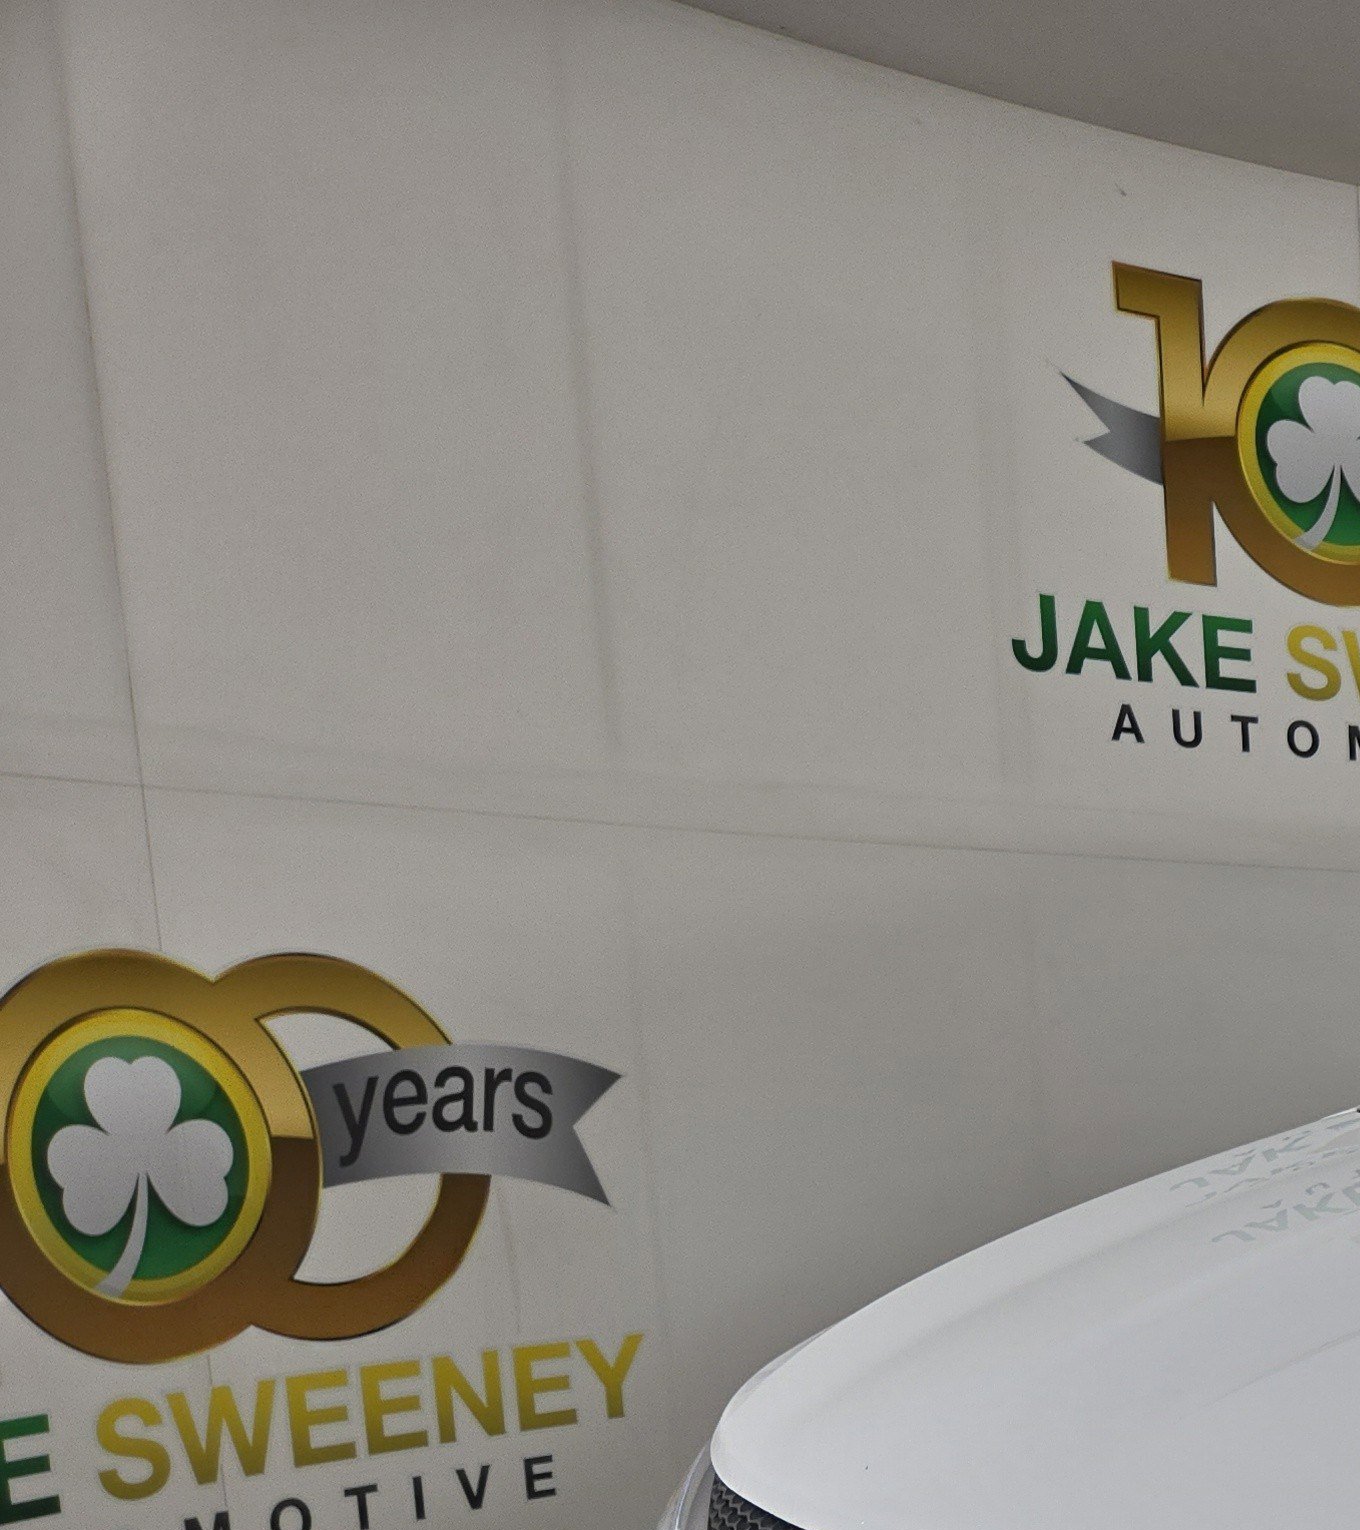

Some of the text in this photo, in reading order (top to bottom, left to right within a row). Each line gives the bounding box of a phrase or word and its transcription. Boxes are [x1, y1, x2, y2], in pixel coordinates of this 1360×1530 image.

[1011, 594, 1256, 693] JAKE
[0, 948, 491, 1364] 00
[334, 1065, 554, 1167] years
[97, 1333, 644, 1501] SWEENEY
